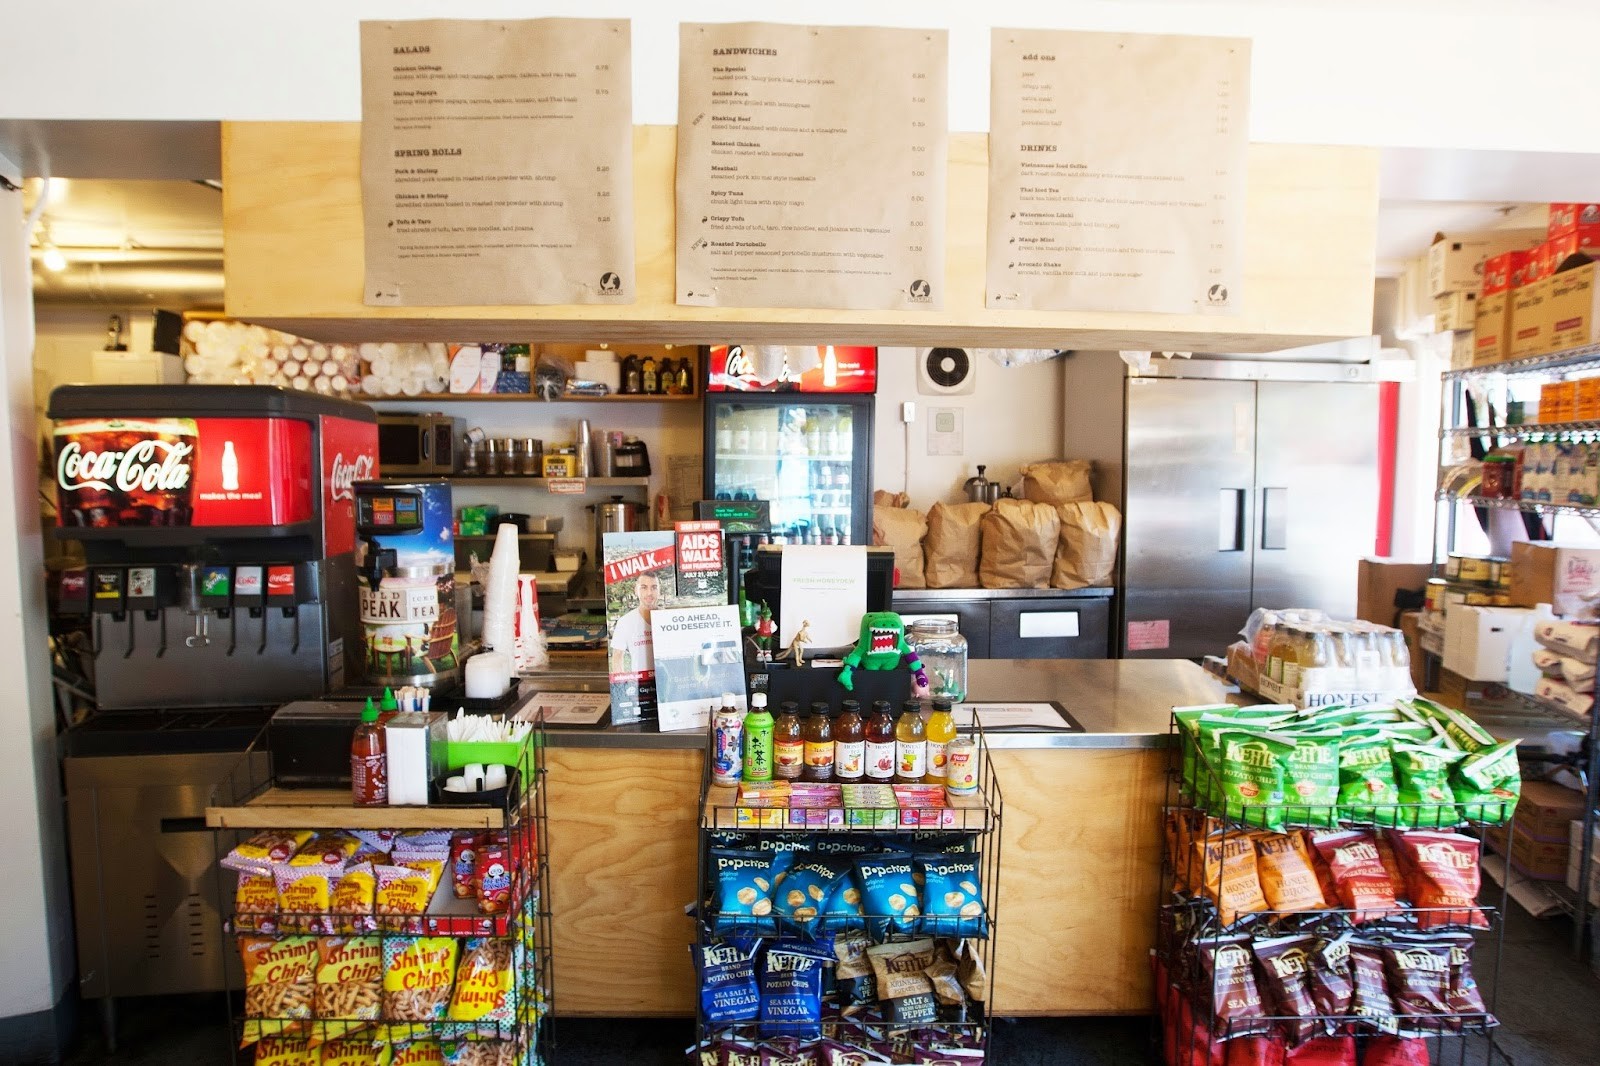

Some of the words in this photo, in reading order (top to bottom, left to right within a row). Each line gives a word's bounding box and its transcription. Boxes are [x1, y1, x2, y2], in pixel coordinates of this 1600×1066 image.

[393, 45, 430, 55] SALADS
[713, 48, 777, 57] SANDWICHES
[711, 114, 736, 123] Shaking
[394, 148, 429, 158] SPRING
[431, 148, 462, 157] ROLLS
[1021, 144, 1058, 153] DRINKS
[710, 189, 726, 198] Spicy
[710, 214, 729, 223] Crispy
[1018, 235, 1038, 244] Mango
[58, 440, 193, 492] Coca-Cola
[681, 534, 719, 550] AIDS
[682, 549, 719, 562] WALK
[609, 565, 617, 580] I
[362, 600, 400, 618] PEAK
[412, 605, 435, 617] TEA
[681, 621, 721, 630] DESERVE
[1224, 769, 1254, 780] POTATO
[1415, 843, 1476, 869] KETTLE
[718, 858, 770, 870] popchips
[861, 864, 911, 879] popchips
[1225, 879, 1257, 893] HONEY
[1276, 876, 1307, 888] HONEY
[283, 883, 316, 898] Shrimp
[382, 880, 418, 898] Shrimp
[1283, 886, 1311, 898] DIJON
[1352, 887, 1394, 896] BARBEQU
[1232, 889, 1258, 903] DIJON
[288, 900, 319, 911] Chips
[387, 898, 416, 911] Chips
[256, 940, 317, 965] Shrimp
[326, 942, 379, 965] Shrim
[390, 948, 450, 971] Shrimp
[766, 952, 816, 973] KETTLE
[885, 955, 934, 974] KETTLE
[721, 963, 740, 971] BRAND
[402, 969, 450, 992] Chips
[707, 972, 735, 983] POTATO
[713, 995, 757, 1008] VINEGAR
[903, 997, 922, 1006] SALT
[1227, 999, 1246, 1008] SEA
[768, 1007, 809, 1015] VINEGAR
[902, 1008, 934, 1019] PEPPER
